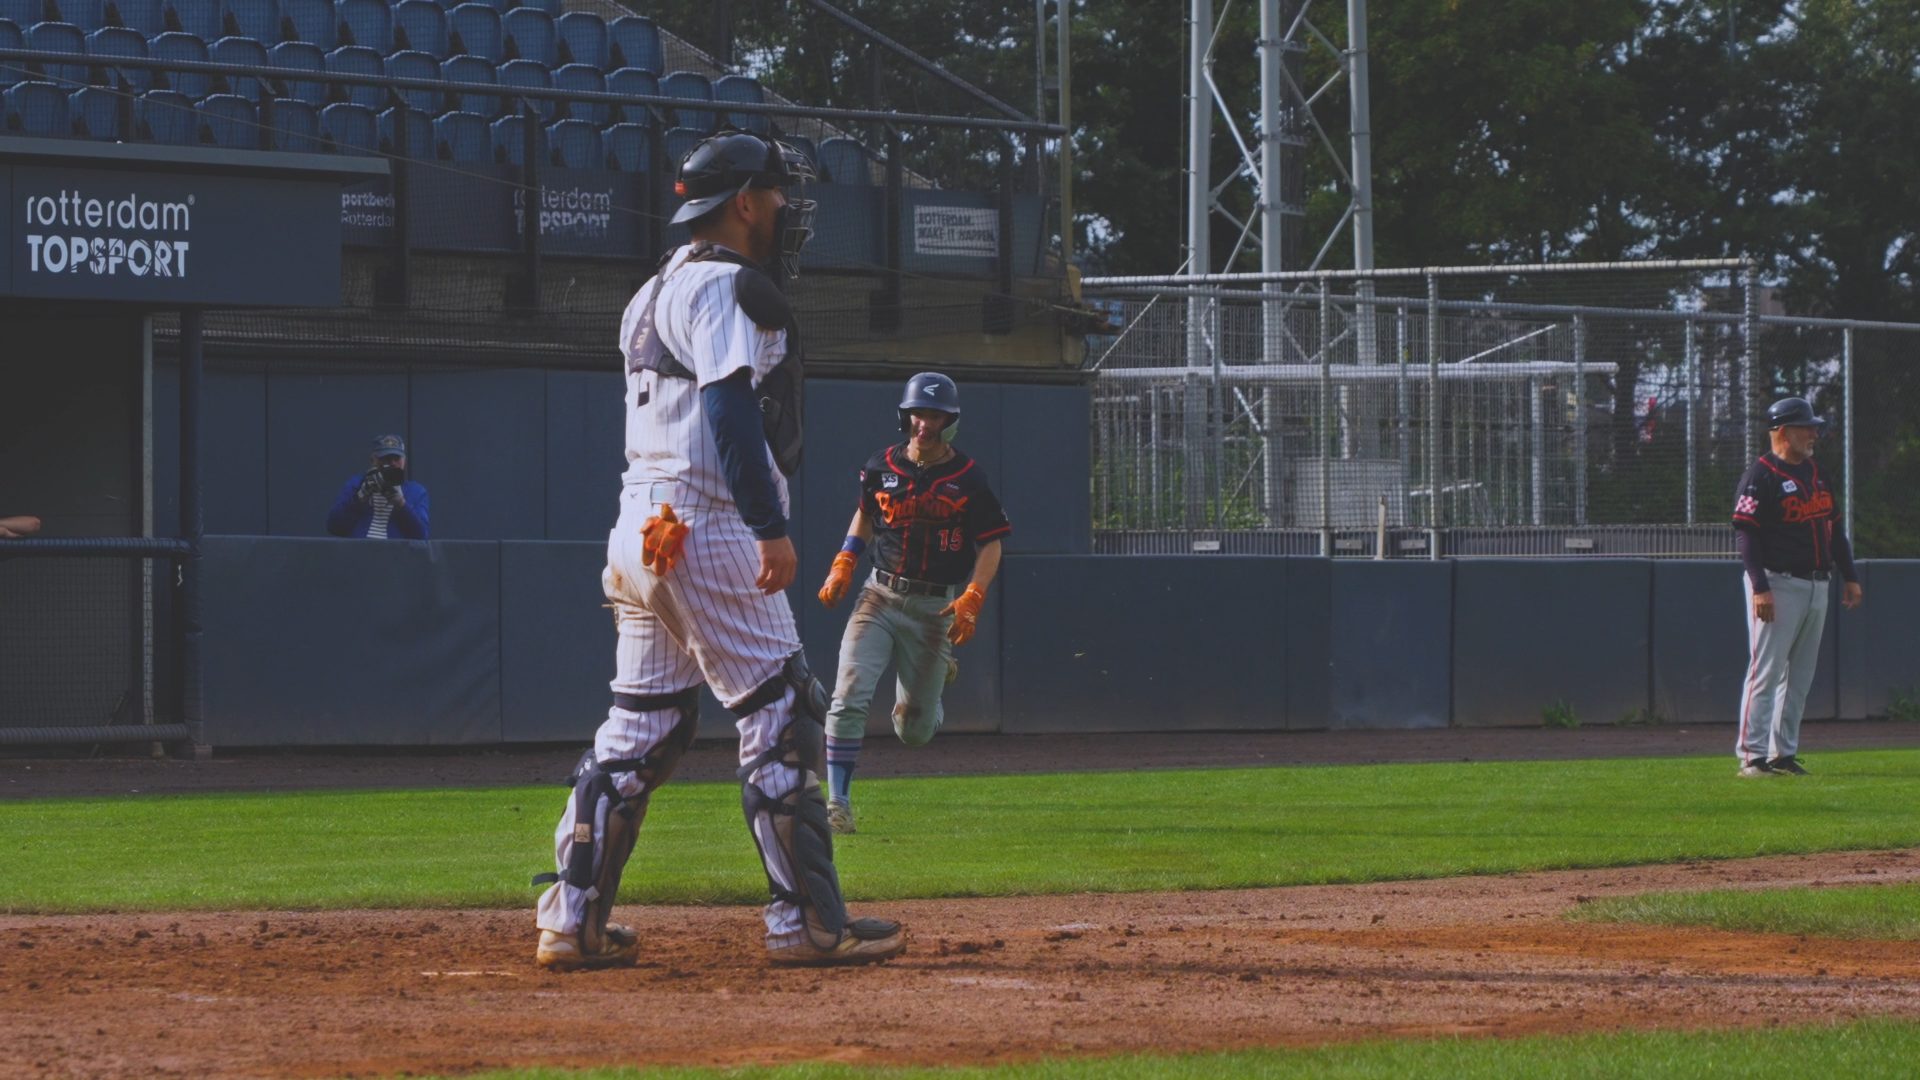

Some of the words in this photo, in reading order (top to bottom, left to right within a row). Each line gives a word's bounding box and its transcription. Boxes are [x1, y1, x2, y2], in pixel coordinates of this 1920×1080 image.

[513, 184, 610, 211] rterdam
[340, 209, 396, 227] Rotterda
[513, 208, 610, 235] TPSPORT
[917, 227, 945, 239] MAKE
[947, 228, 955, 241] IT
[27, 234, 189, 277] TOPSPORT
[938, 528, 963, 551] 15
